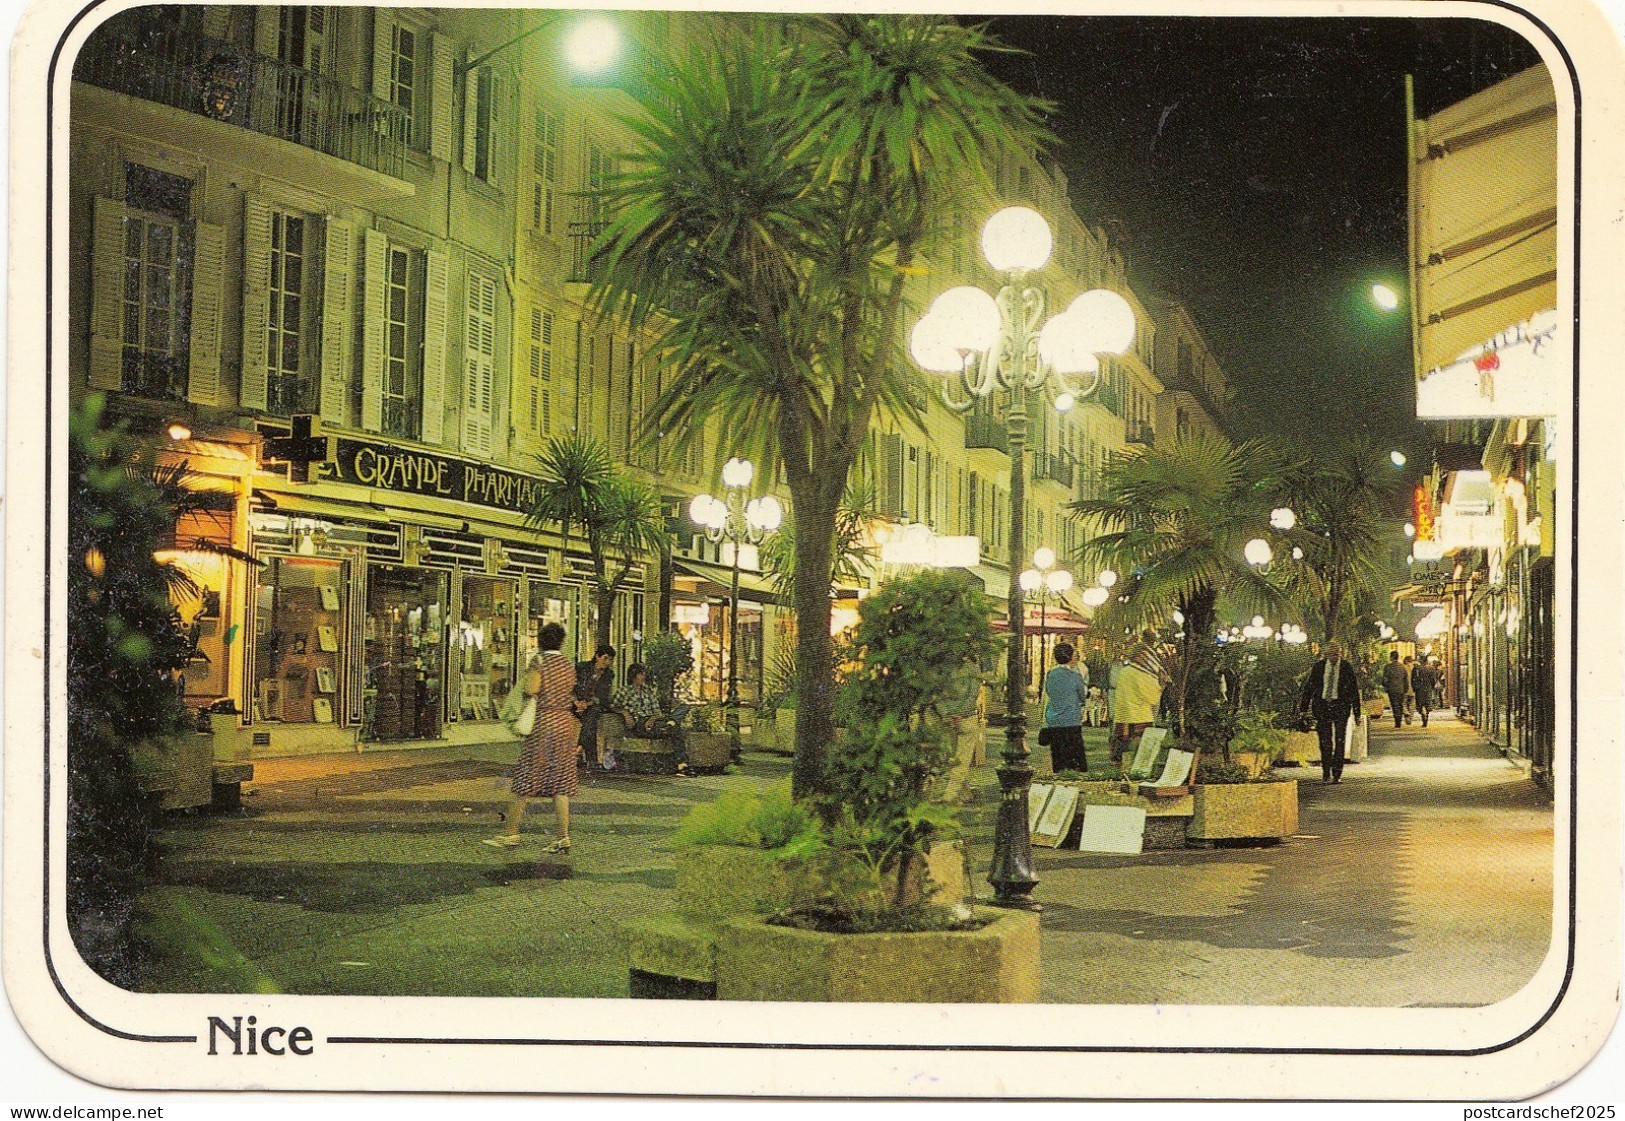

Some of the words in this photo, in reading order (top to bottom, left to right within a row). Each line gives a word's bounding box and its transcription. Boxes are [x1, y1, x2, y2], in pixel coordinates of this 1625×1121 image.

[354, 447, 452, 493] GRANDE
[464, 466, 548, 507] PHARMACI
[207, 1015, 313, 1056] Nice
